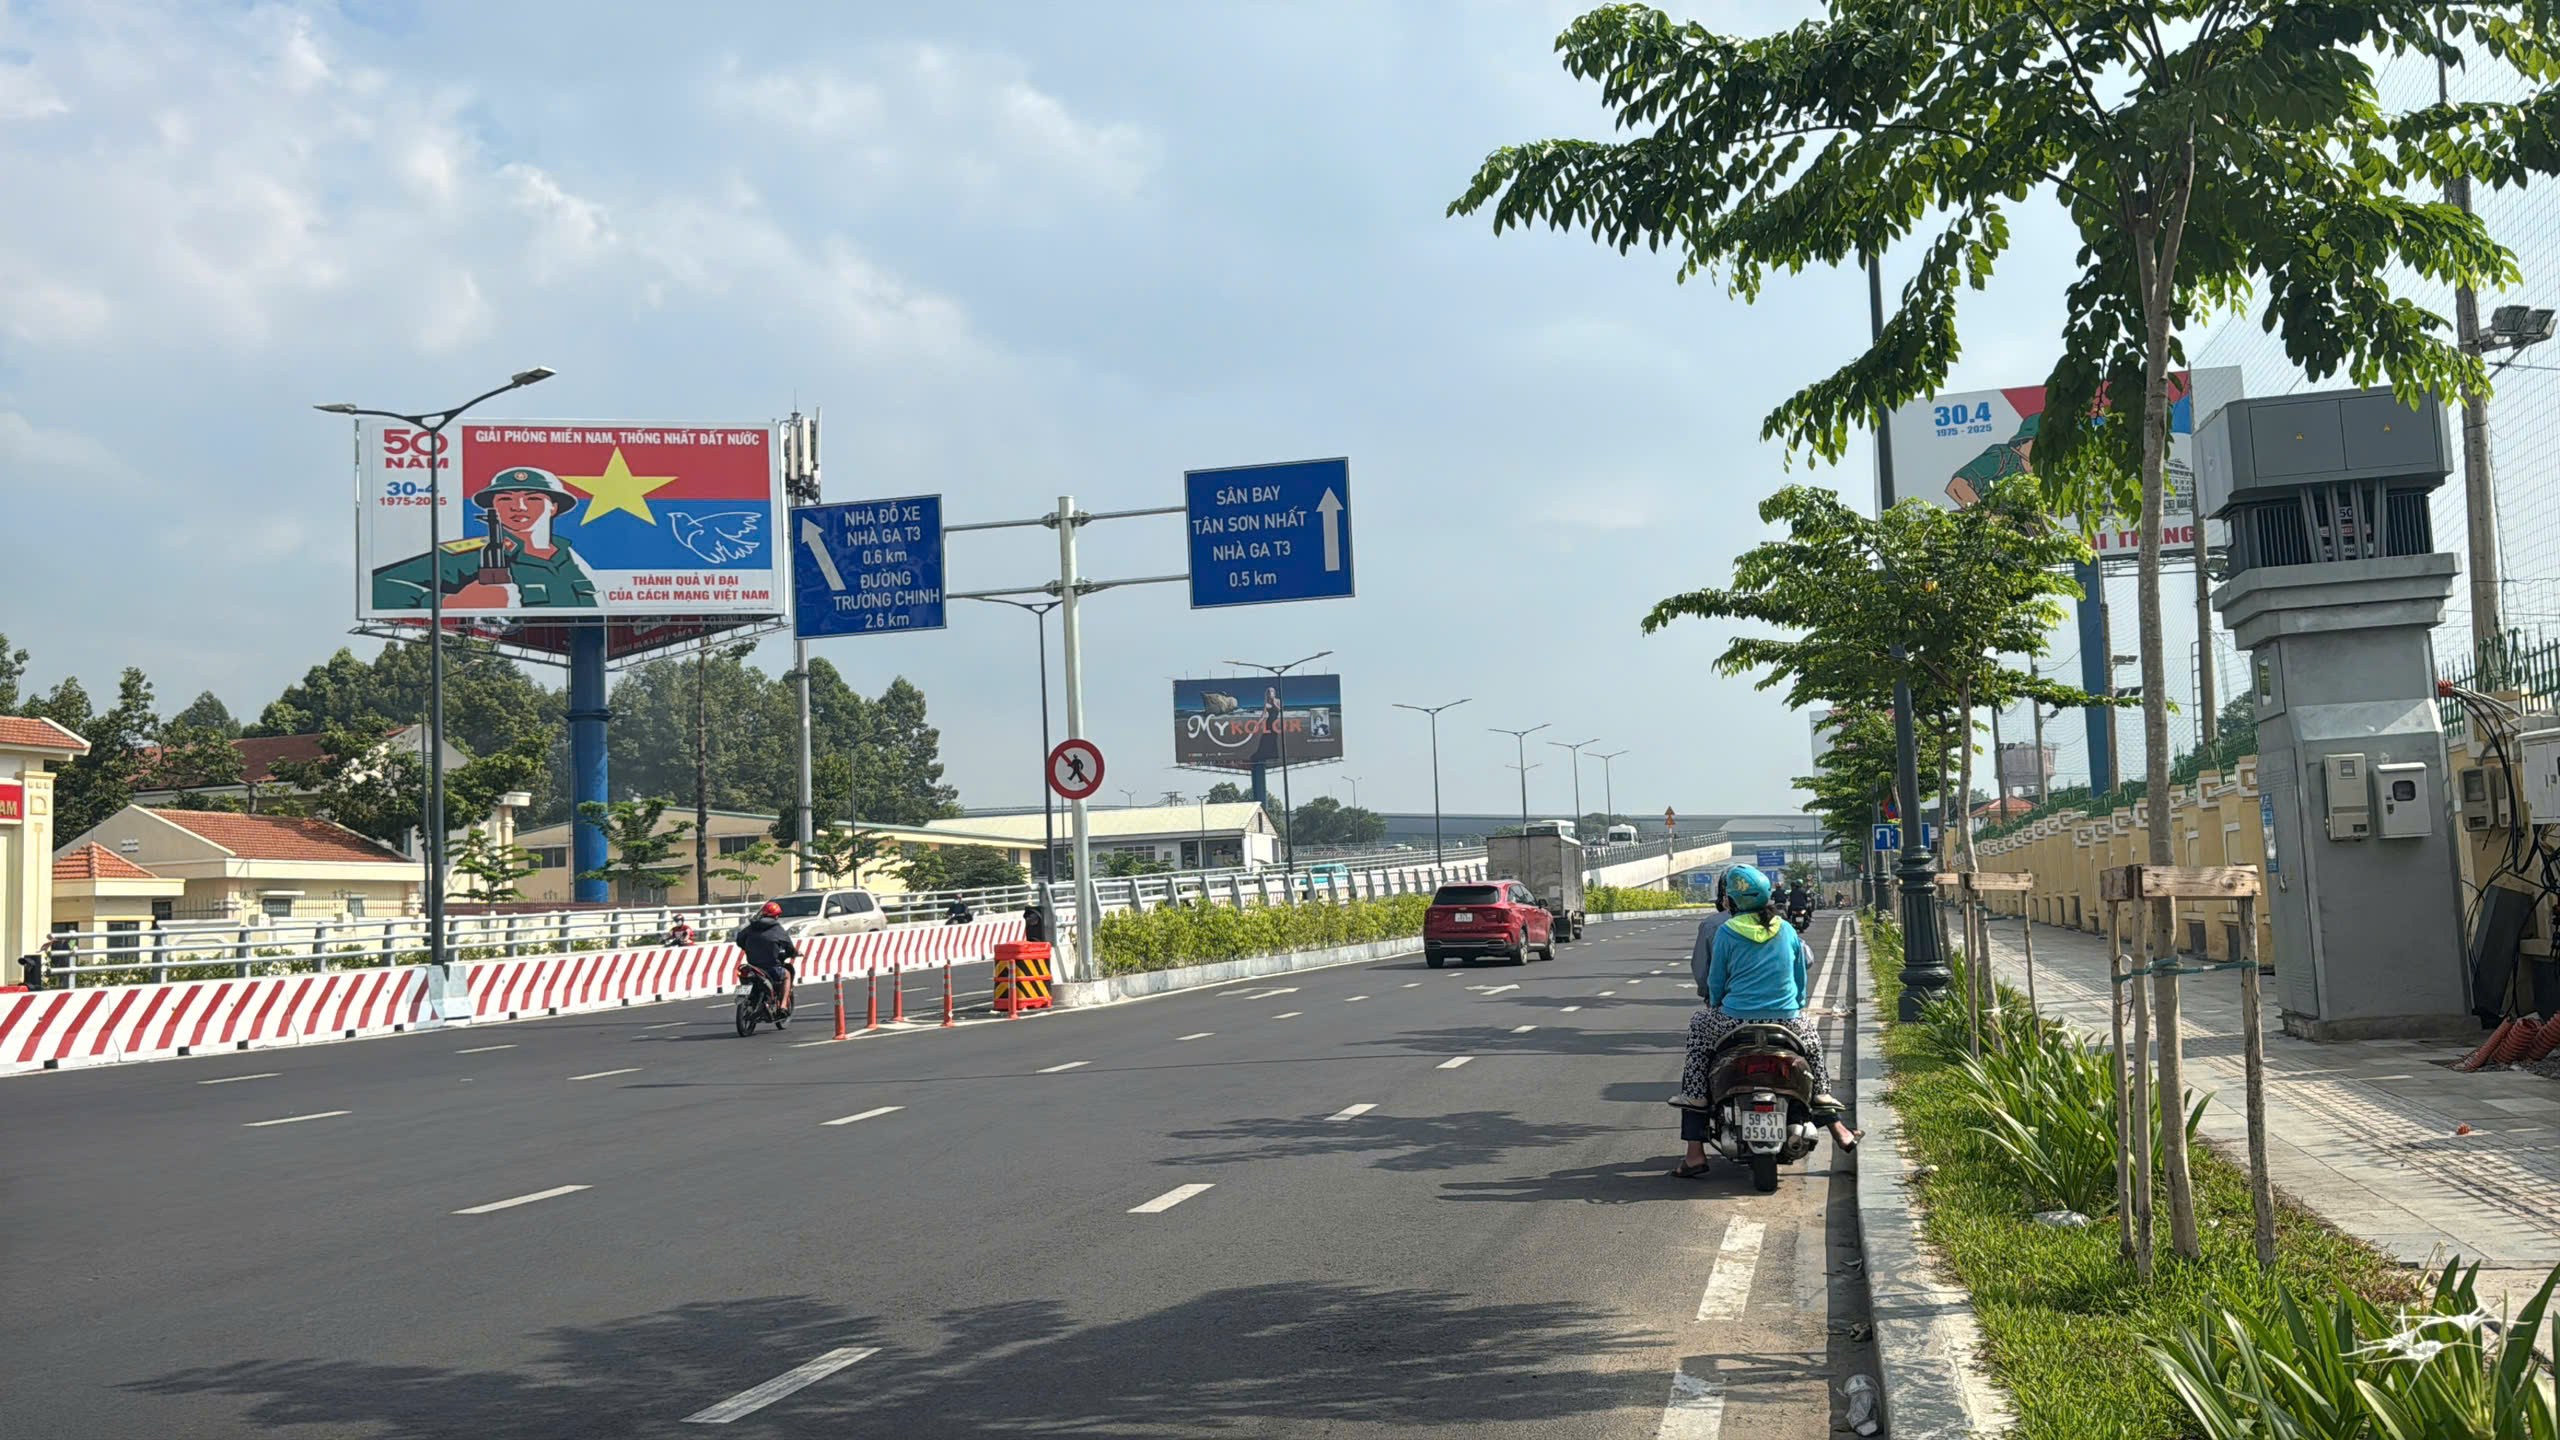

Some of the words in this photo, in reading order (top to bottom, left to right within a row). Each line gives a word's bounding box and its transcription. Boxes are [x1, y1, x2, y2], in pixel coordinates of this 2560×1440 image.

[1935, 402, 1992, 426] 30.4
[475, 426, 501, 442] GIẢI
[504, 427, 547, 443] PHÓNG
[585, 431, 617, 446] NAM,
[619, 428, 661, 444] THỐNG
[664, 429, 696, 445] NHẤT
[699, 429, 724, 445] ĐẤT
[727, 431, 760, 446] NƯỚC
[1936, 428, 1958, 437] 1975
[1967, 424, 1993, 434] 2025
[384, 429, 449, 456] 50
[385, 454, 449, 469] NĂM
[379, 496, 448, 506] 1975-205
[1216, 486, 1248, 506] SÂN
[1252, 485, 1281, 503] BAY
[844, 506, 876, 527] NHÀ
[879, 502, 899, 524] ĐỖ
[902, 506, 921, 521] XE
[1192, 515, 1224, 535] TÂN
[1228, 514, 1260, 533] SƠN
[1264, 505, 1308, 529] NHẤT
[846, 526, 879, 547] NHÀ
[882, 528, 902, 544] GA
[904, 526, 921, 542] T3
[862, 549, 883, 565] 0.6
[886, 548, 908, 563] km
[1213, 540, 1246, 561] NHÀ
[1250, 542, 1271, 558] GA
[1273, 540, 1291, 556] T3
[632, 573, 673, 586] THÀNH
[675, 572, 701, 586] QUẢ
[704, 574, 716, 586] VĨ
[718, 575, 739, 588] ĐẠI
[860, 568, 912, 589] ĐƯỜNG
[1229, 570, 1250, 588] 0.5
[1254, 570, 1277, 586] km
[608, 587, 634, 601] CỦA
[636, 589, 670, 601] CÁCH
[673, 590, 710, 603] MẠNG
[713, 590, 738, 602] VIỆT
[741, 590, 769, 600] NAM
[832, 590, 892, 611] TRƯỜNG
[895, 588, 940, 606] CHINH
[865, 613, 885, 629] 2.6
[888, 613, 910, 627] km
[1744, 1126, 1784, 1140] 359.40
